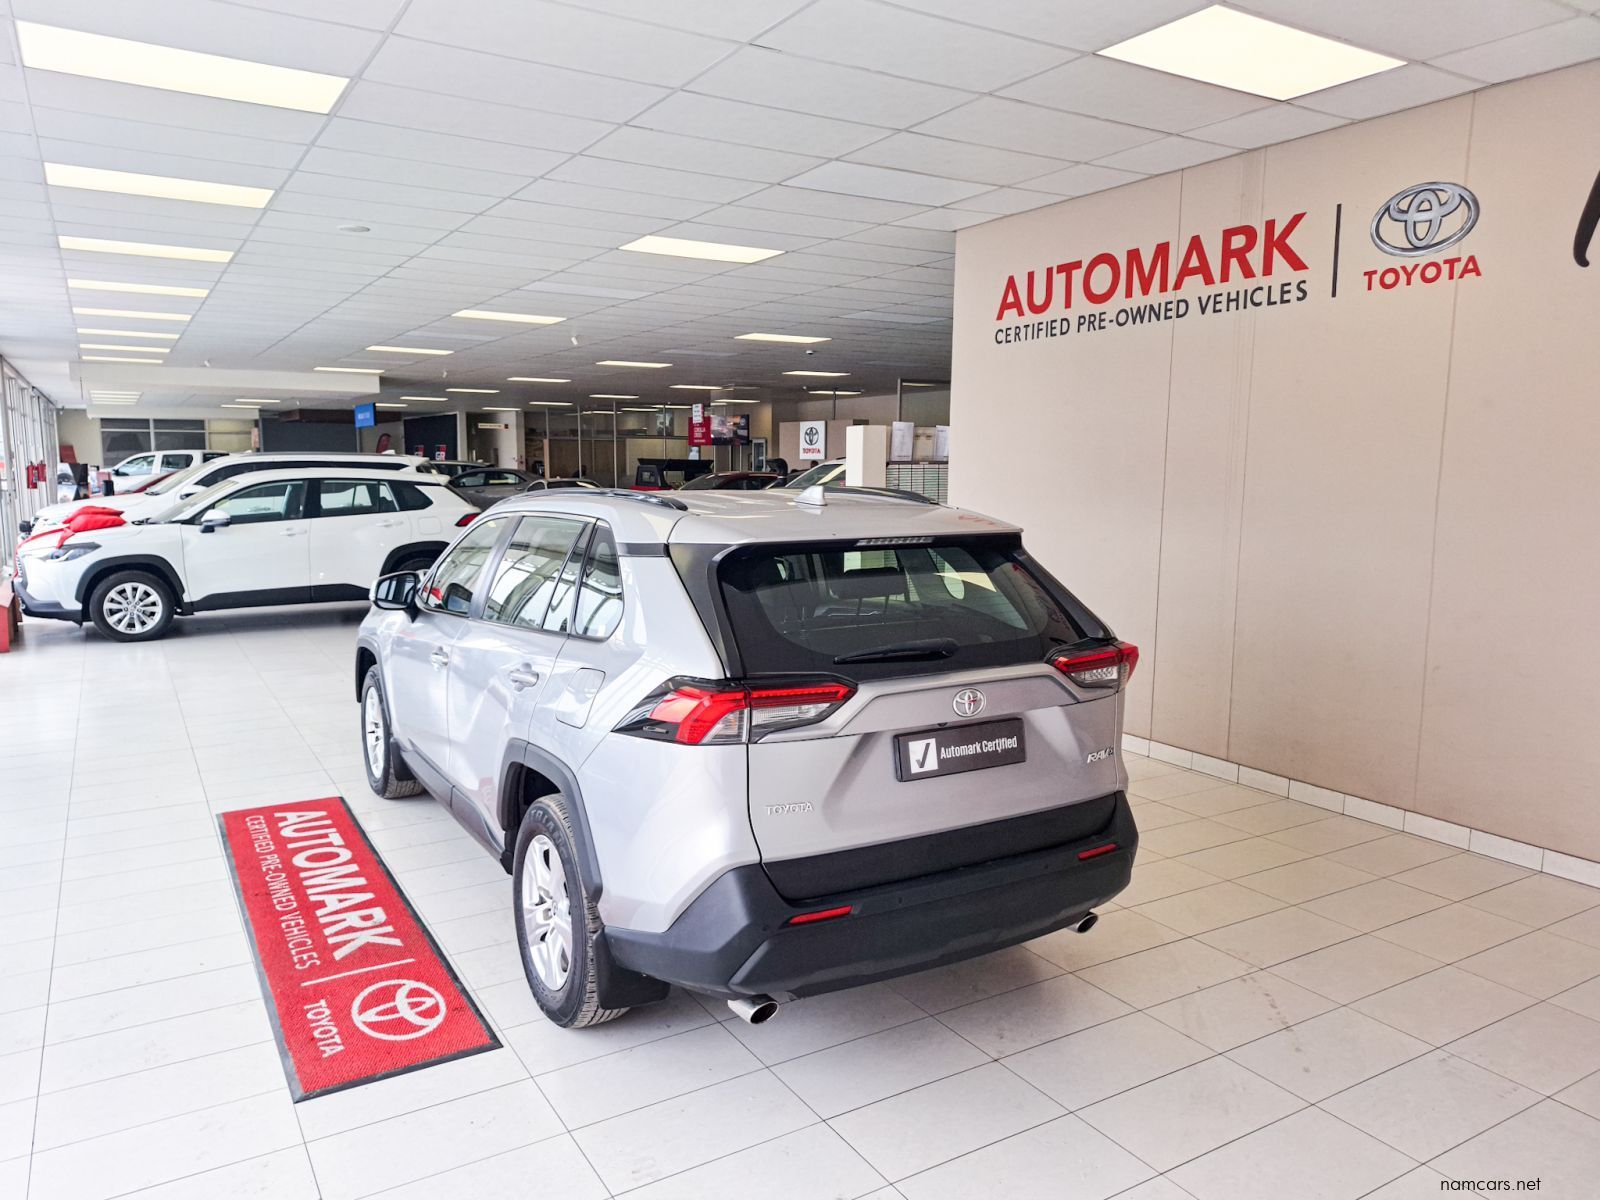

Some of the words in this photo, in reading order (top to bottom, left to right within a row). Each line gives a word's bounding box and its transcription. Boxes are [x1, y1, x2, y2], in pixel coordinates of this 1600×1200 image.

[996, 212, 1309, 321] AUTOMARK
[1363, 255, 1482, 292] TOYOTA
[995, 317, 1070, 345] CERTIFIED
[1077, 298, 1189, 333] PRE-OWNED
[1198, 279, 1308, 315] VEHICLES
[802, 447, 821, 455] TOYOTA
[940, 741, 982, 760] Automark
[982, 735, 1018, 754] Certified
[764, 801, 814, 816] TOYOTA
[244, 815, 274, 854] CERTIFIED
[259, 853, 297, 913] PRE-OWNED
[279, 911, 321, 970] VEHICLES
[274, 810, 404, 961] AUTOMARK
[303, 999, 344, 1058] TOYOTA
